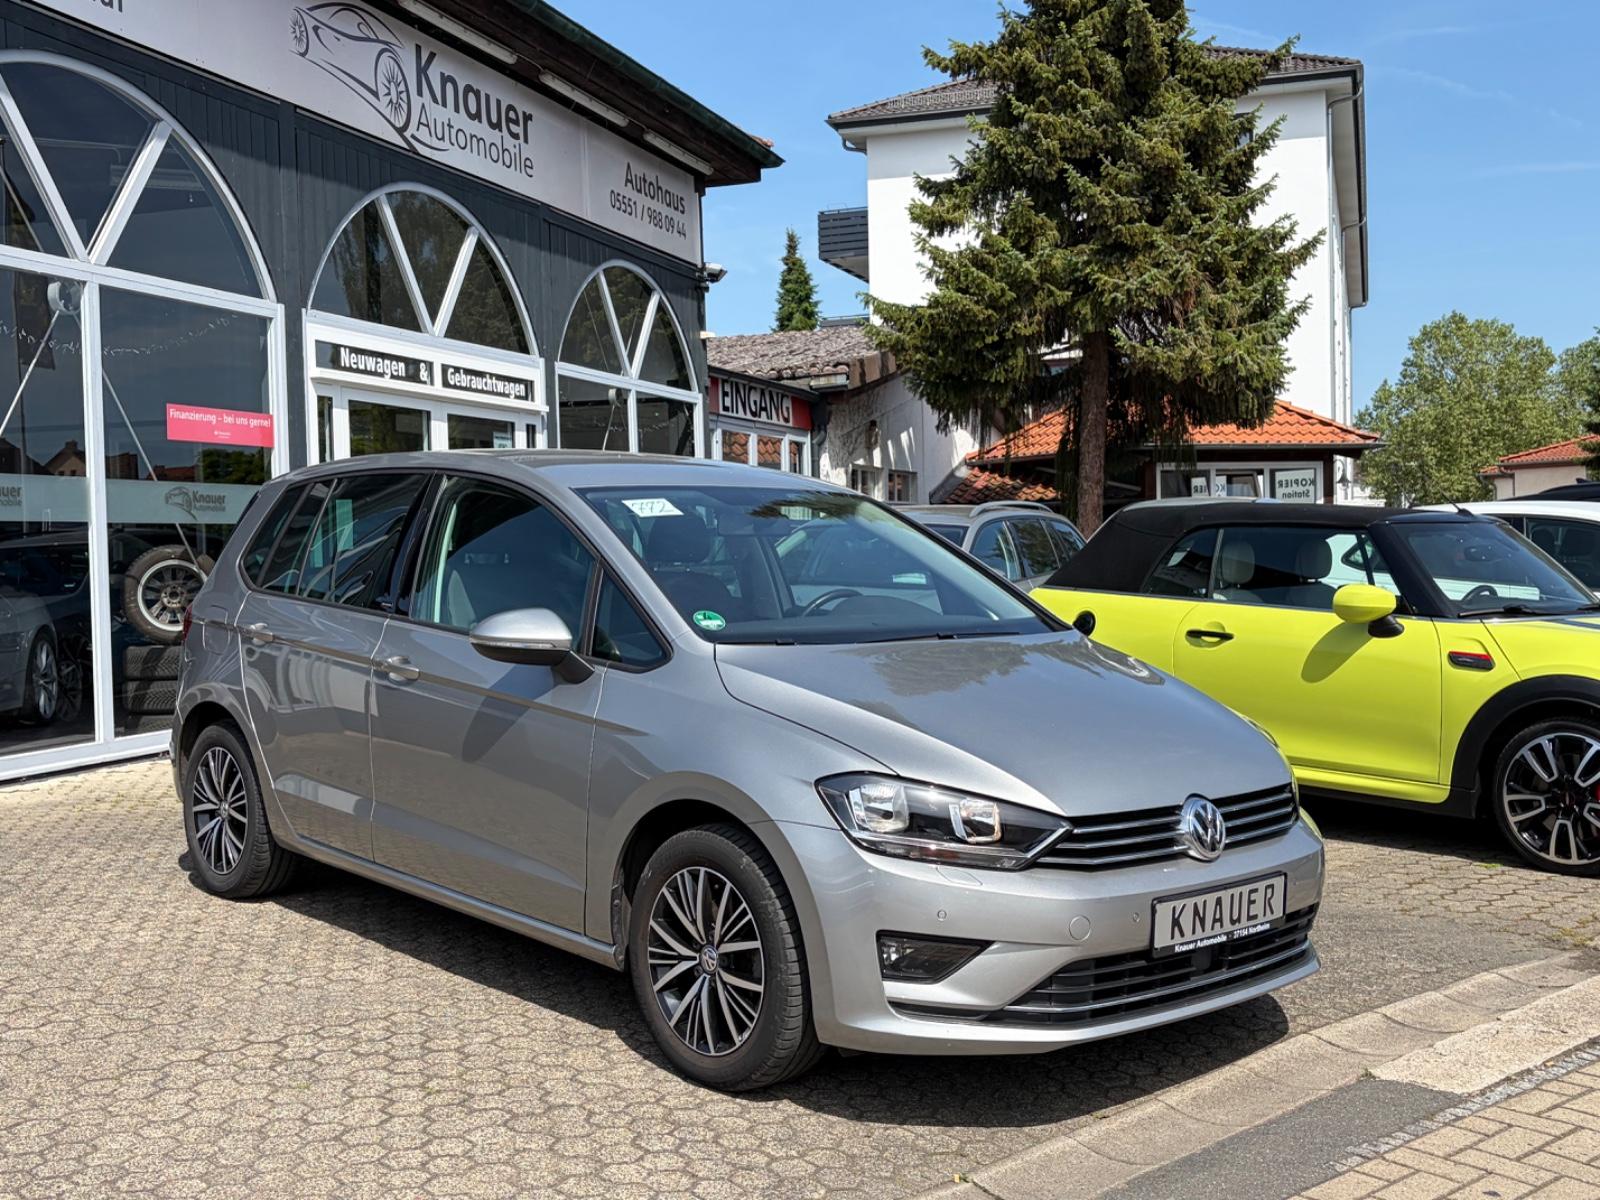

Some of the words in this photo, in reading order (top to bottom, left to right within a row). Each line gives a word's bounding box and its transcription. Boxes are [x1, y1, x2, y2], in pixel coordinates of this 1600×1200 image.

[415, 43, 533, 145] Knauer
[416, 102, 534, 178] Automobile
[624, 161, 686, 215] Autohaus
[610, 189, 638, 219] 05551
[647, 206, 663, 230] 988
[664, 214, 675, 234] 09
[676, 220, 687, 240] 44
[340, 347, 405, 379] Neuwagen
[419, 361, 429, 383] &
[447, 367, 526, 399] Gebrauchtwagen
[169, 408, 217, 425] Finanzierung
[223, 413, 235, 424] bei
[235, 416, 248, 425] uns
[249, 418, 271, 428] gerne!
[721, 380, 791, 424] EINGANG
[0, 486, 22, 497] uer
[192, 490, 226, 505] Knauer
[1170, 883, 1275, 940] KNAUER
[1174, 942, 1196, 953] Knauer
[1196, 933, 1227, 948] Automobile
